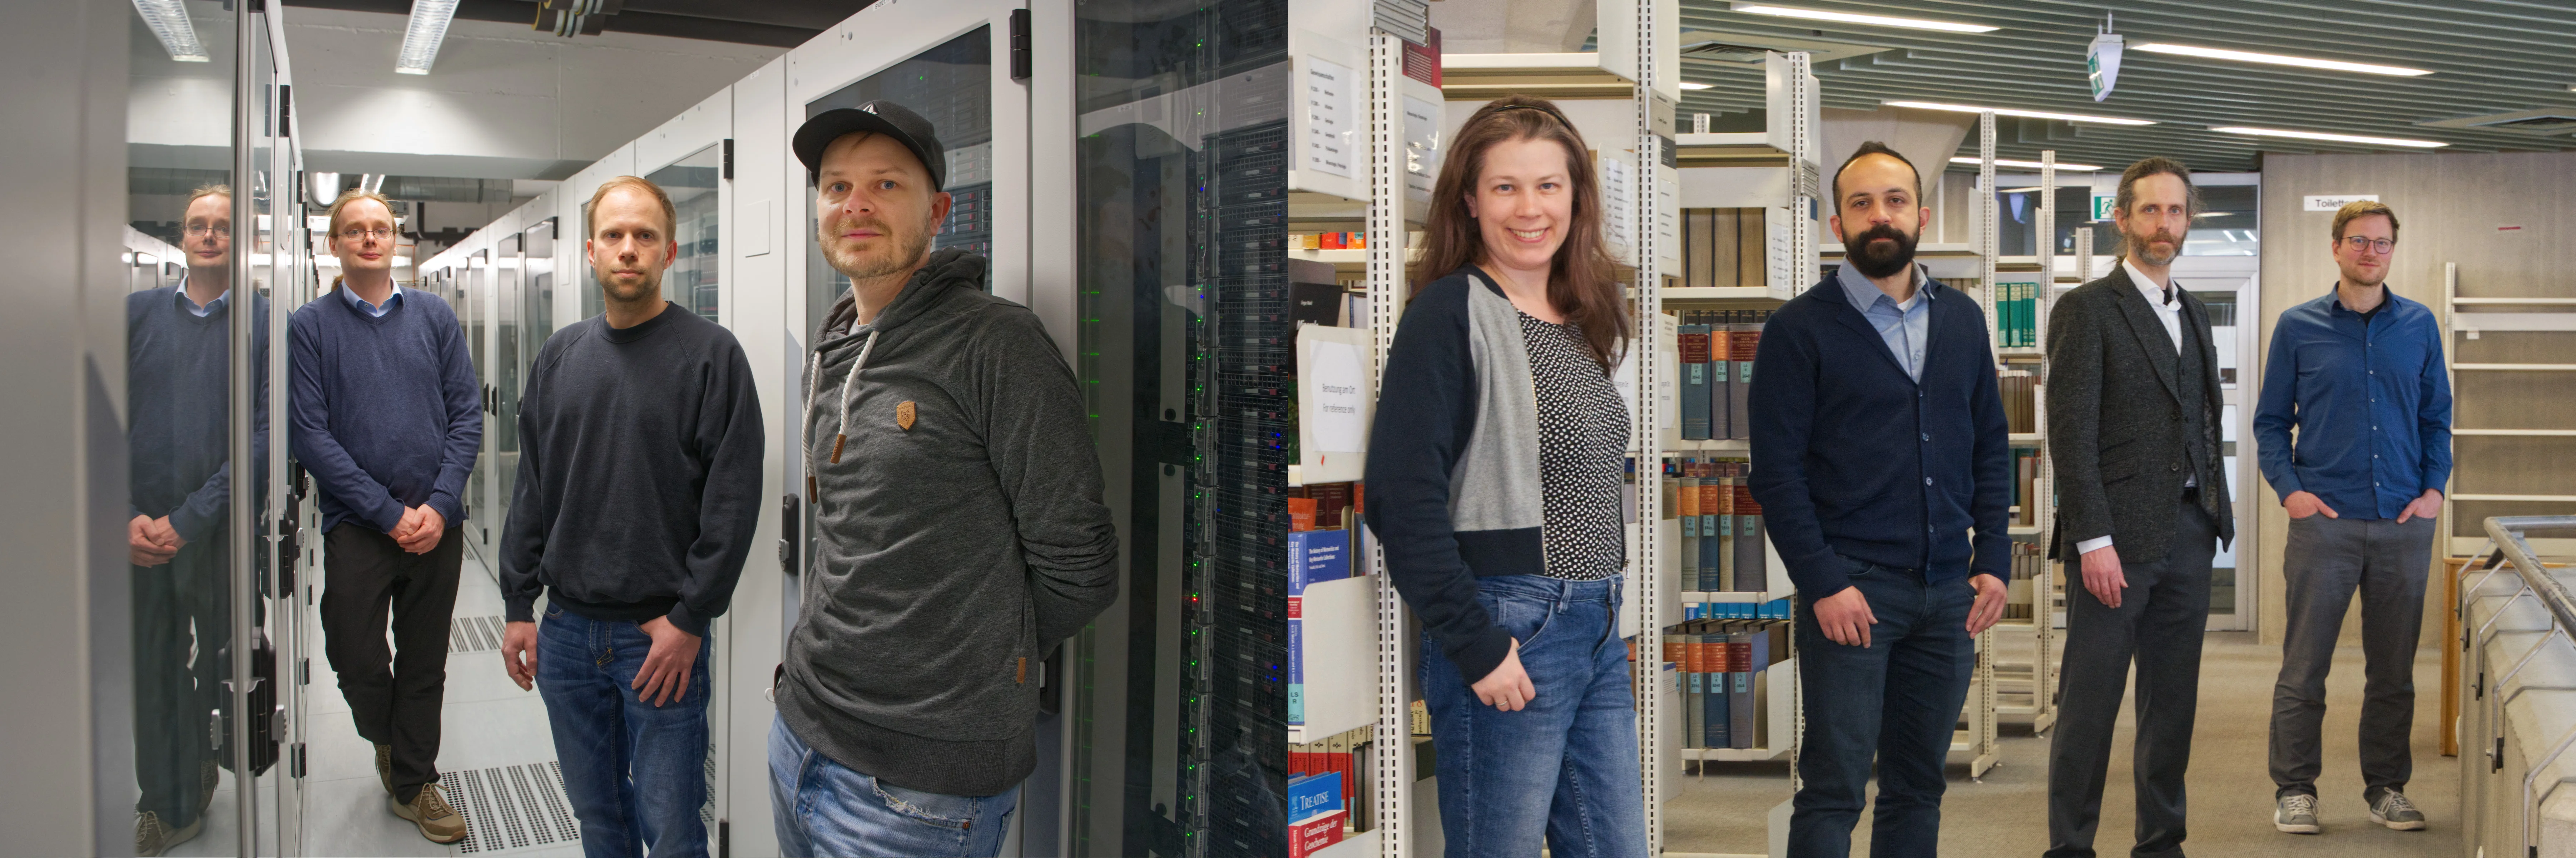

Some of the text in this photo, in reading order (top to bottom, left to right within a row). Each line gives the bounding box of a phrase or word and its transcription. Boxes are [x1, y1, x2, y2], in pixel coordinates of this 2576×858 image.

[1322, 383, 1341, 395] Benutzung
[1330, 404, 1347, 413] reference
[1179, 763, 1186, 771] 18
[1178, 786, 1185, 795] 26
[1177, 819, 1184, 828] 27
[1177, 828, 1184, 836] 16
[1305, 823, 1329, 837] Grundzüge
[1305, 835, 1329, 851] Geochemie
